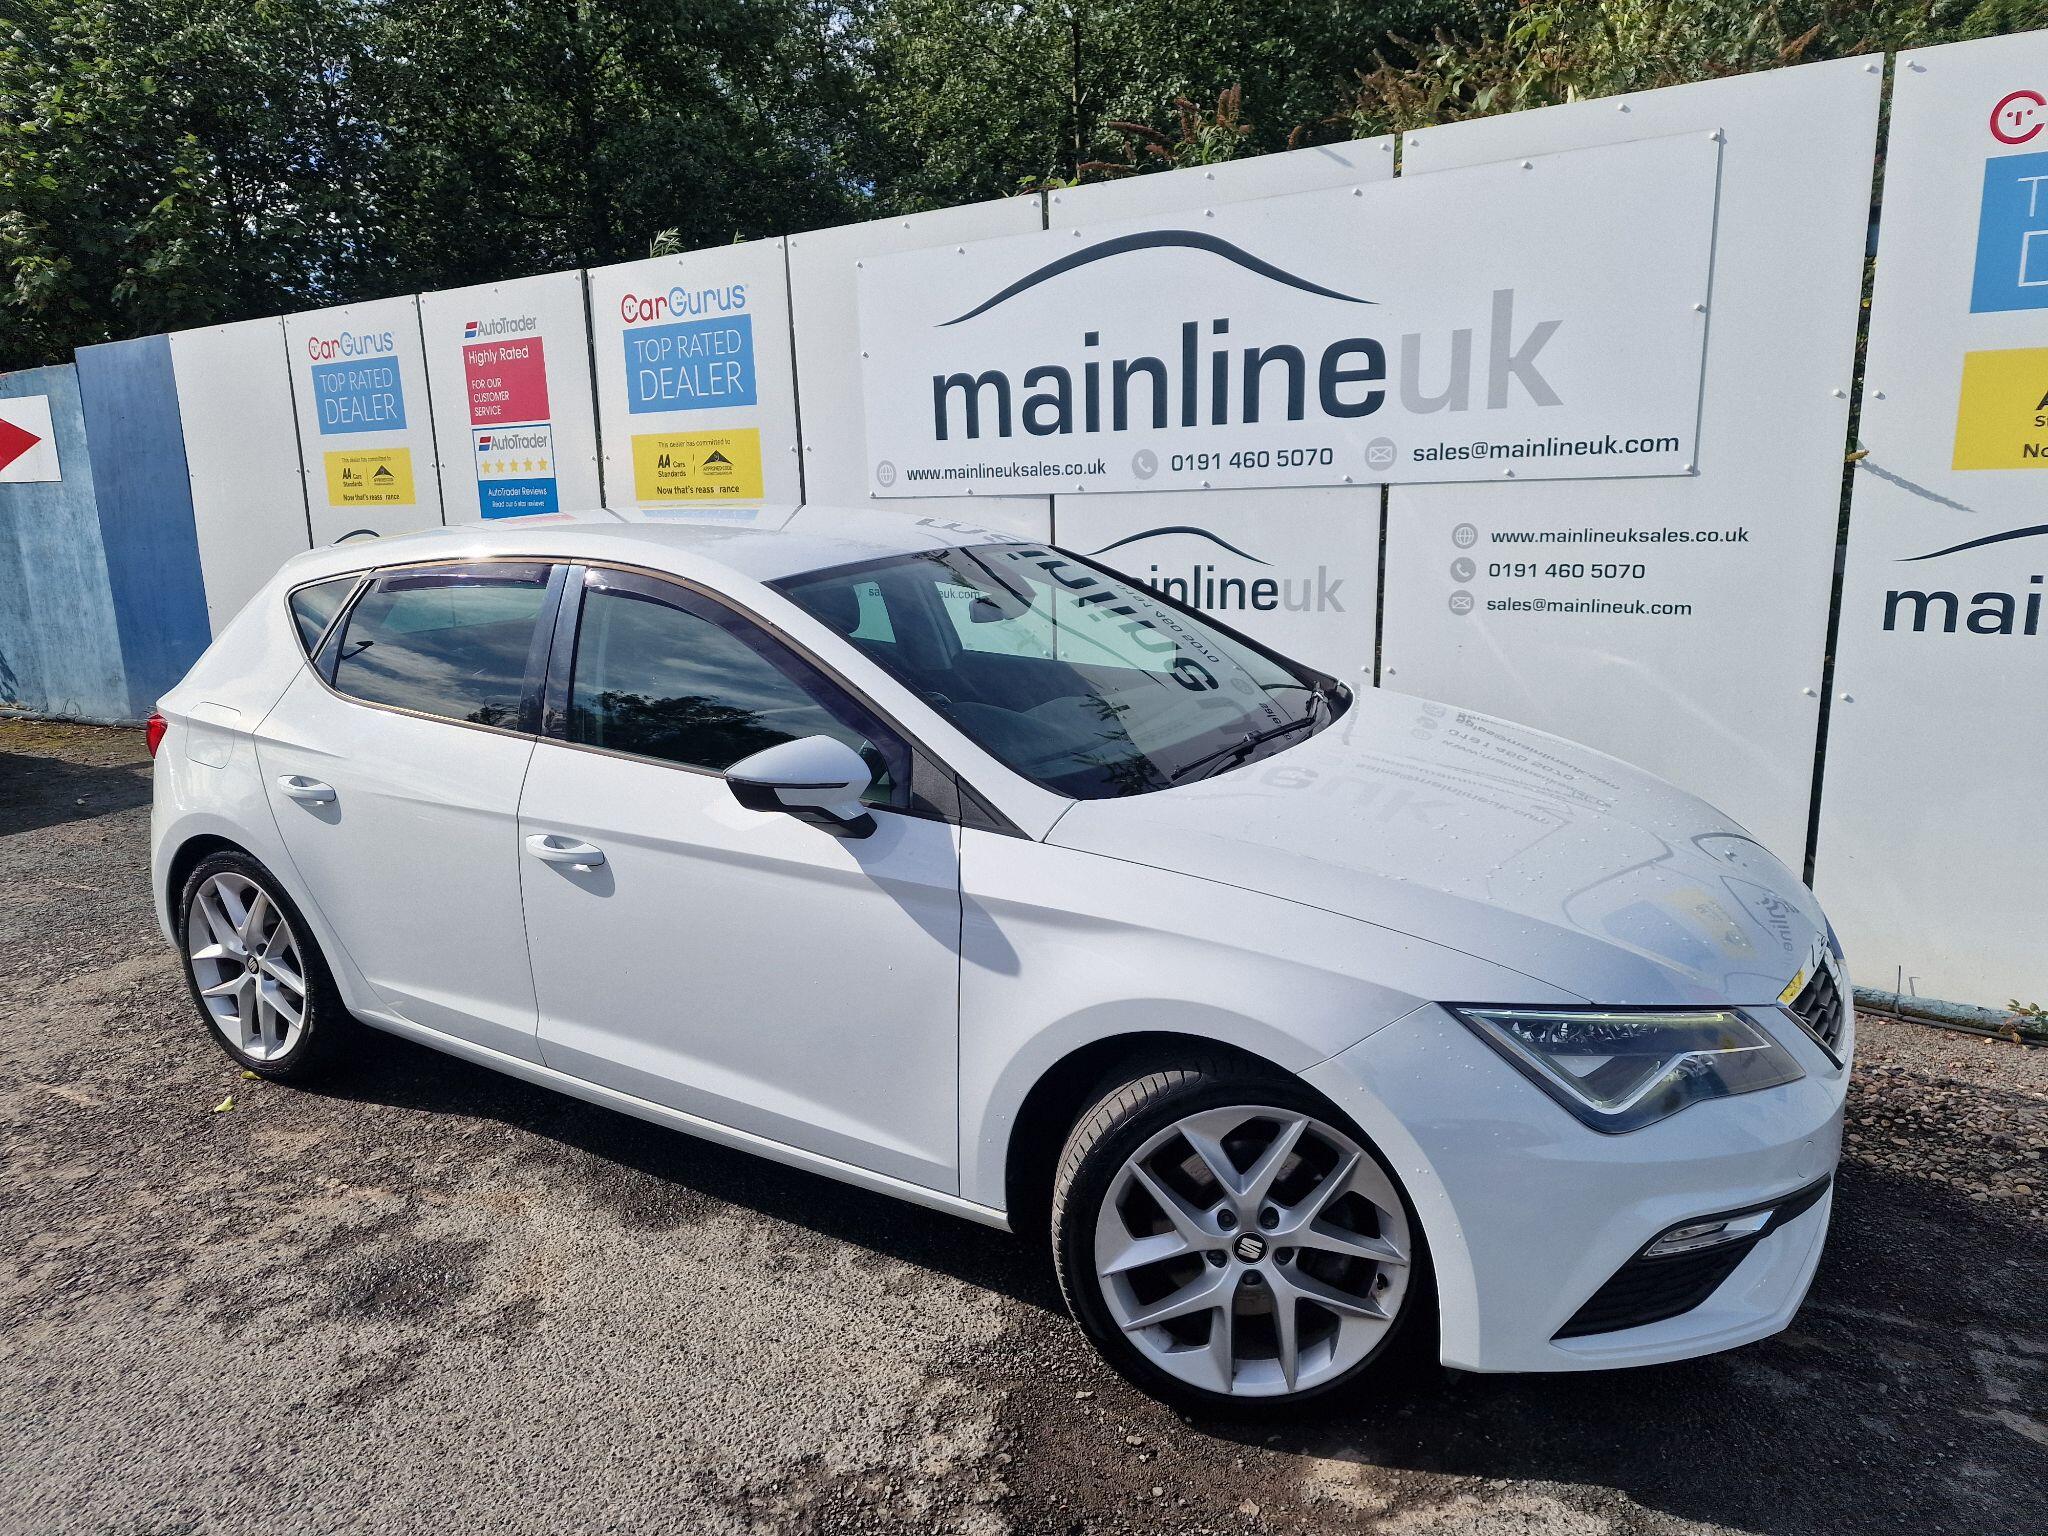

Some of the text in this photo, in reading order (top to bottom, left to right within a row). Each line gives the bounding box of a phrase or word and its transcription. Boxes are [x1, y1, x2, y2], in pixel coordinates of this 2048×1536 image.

[621, 284, 746, 324] CarGurus
[478, 314, 537, 337] AutoTrader
[308, 331, 394, 361] CarGurus
[468, 345, 529, 367] Highly Rated
[634, 329, 742, 363] TOP RATED
[932, 289, 1563, 441] mainlineuk
[319, 367, 393, 393] TOP RATED
[472, 378, 502, 389] FOR OUR
[639, 361, 744, 401] DEALER
[474, 391, 509, 403] CUSTOMER
[325, 393, 398, 425] DEALER
[474, 405, 502, 417] SERVICE
[491, 433, 547, 450] AutoTrader
[1412, 435, 1679, 463] sales@mainlineuk.com
[657, 453, 671, 468] AA
[906, 459, 1106, 481] www.mainlineuksales.co.uk
[1171, 448, 1334, 472] 0191 460 5070
[342, 467, 352, 479] AA
[658, 470, 686, 478] Standards
[521, 485, 548, 496] Reviews
[656, 486, 673, 494] Now
[674, 485, 694, 494] that's
[1490, 526, 1749, 545] www.mainlineuksales.co.uk
[1488, 562, 1646, 580] 0191 460 5070
[1134, 564, 1346, 612] inlineuk
[1487, 596, 1692, 616] sales@mainlineuk.com
